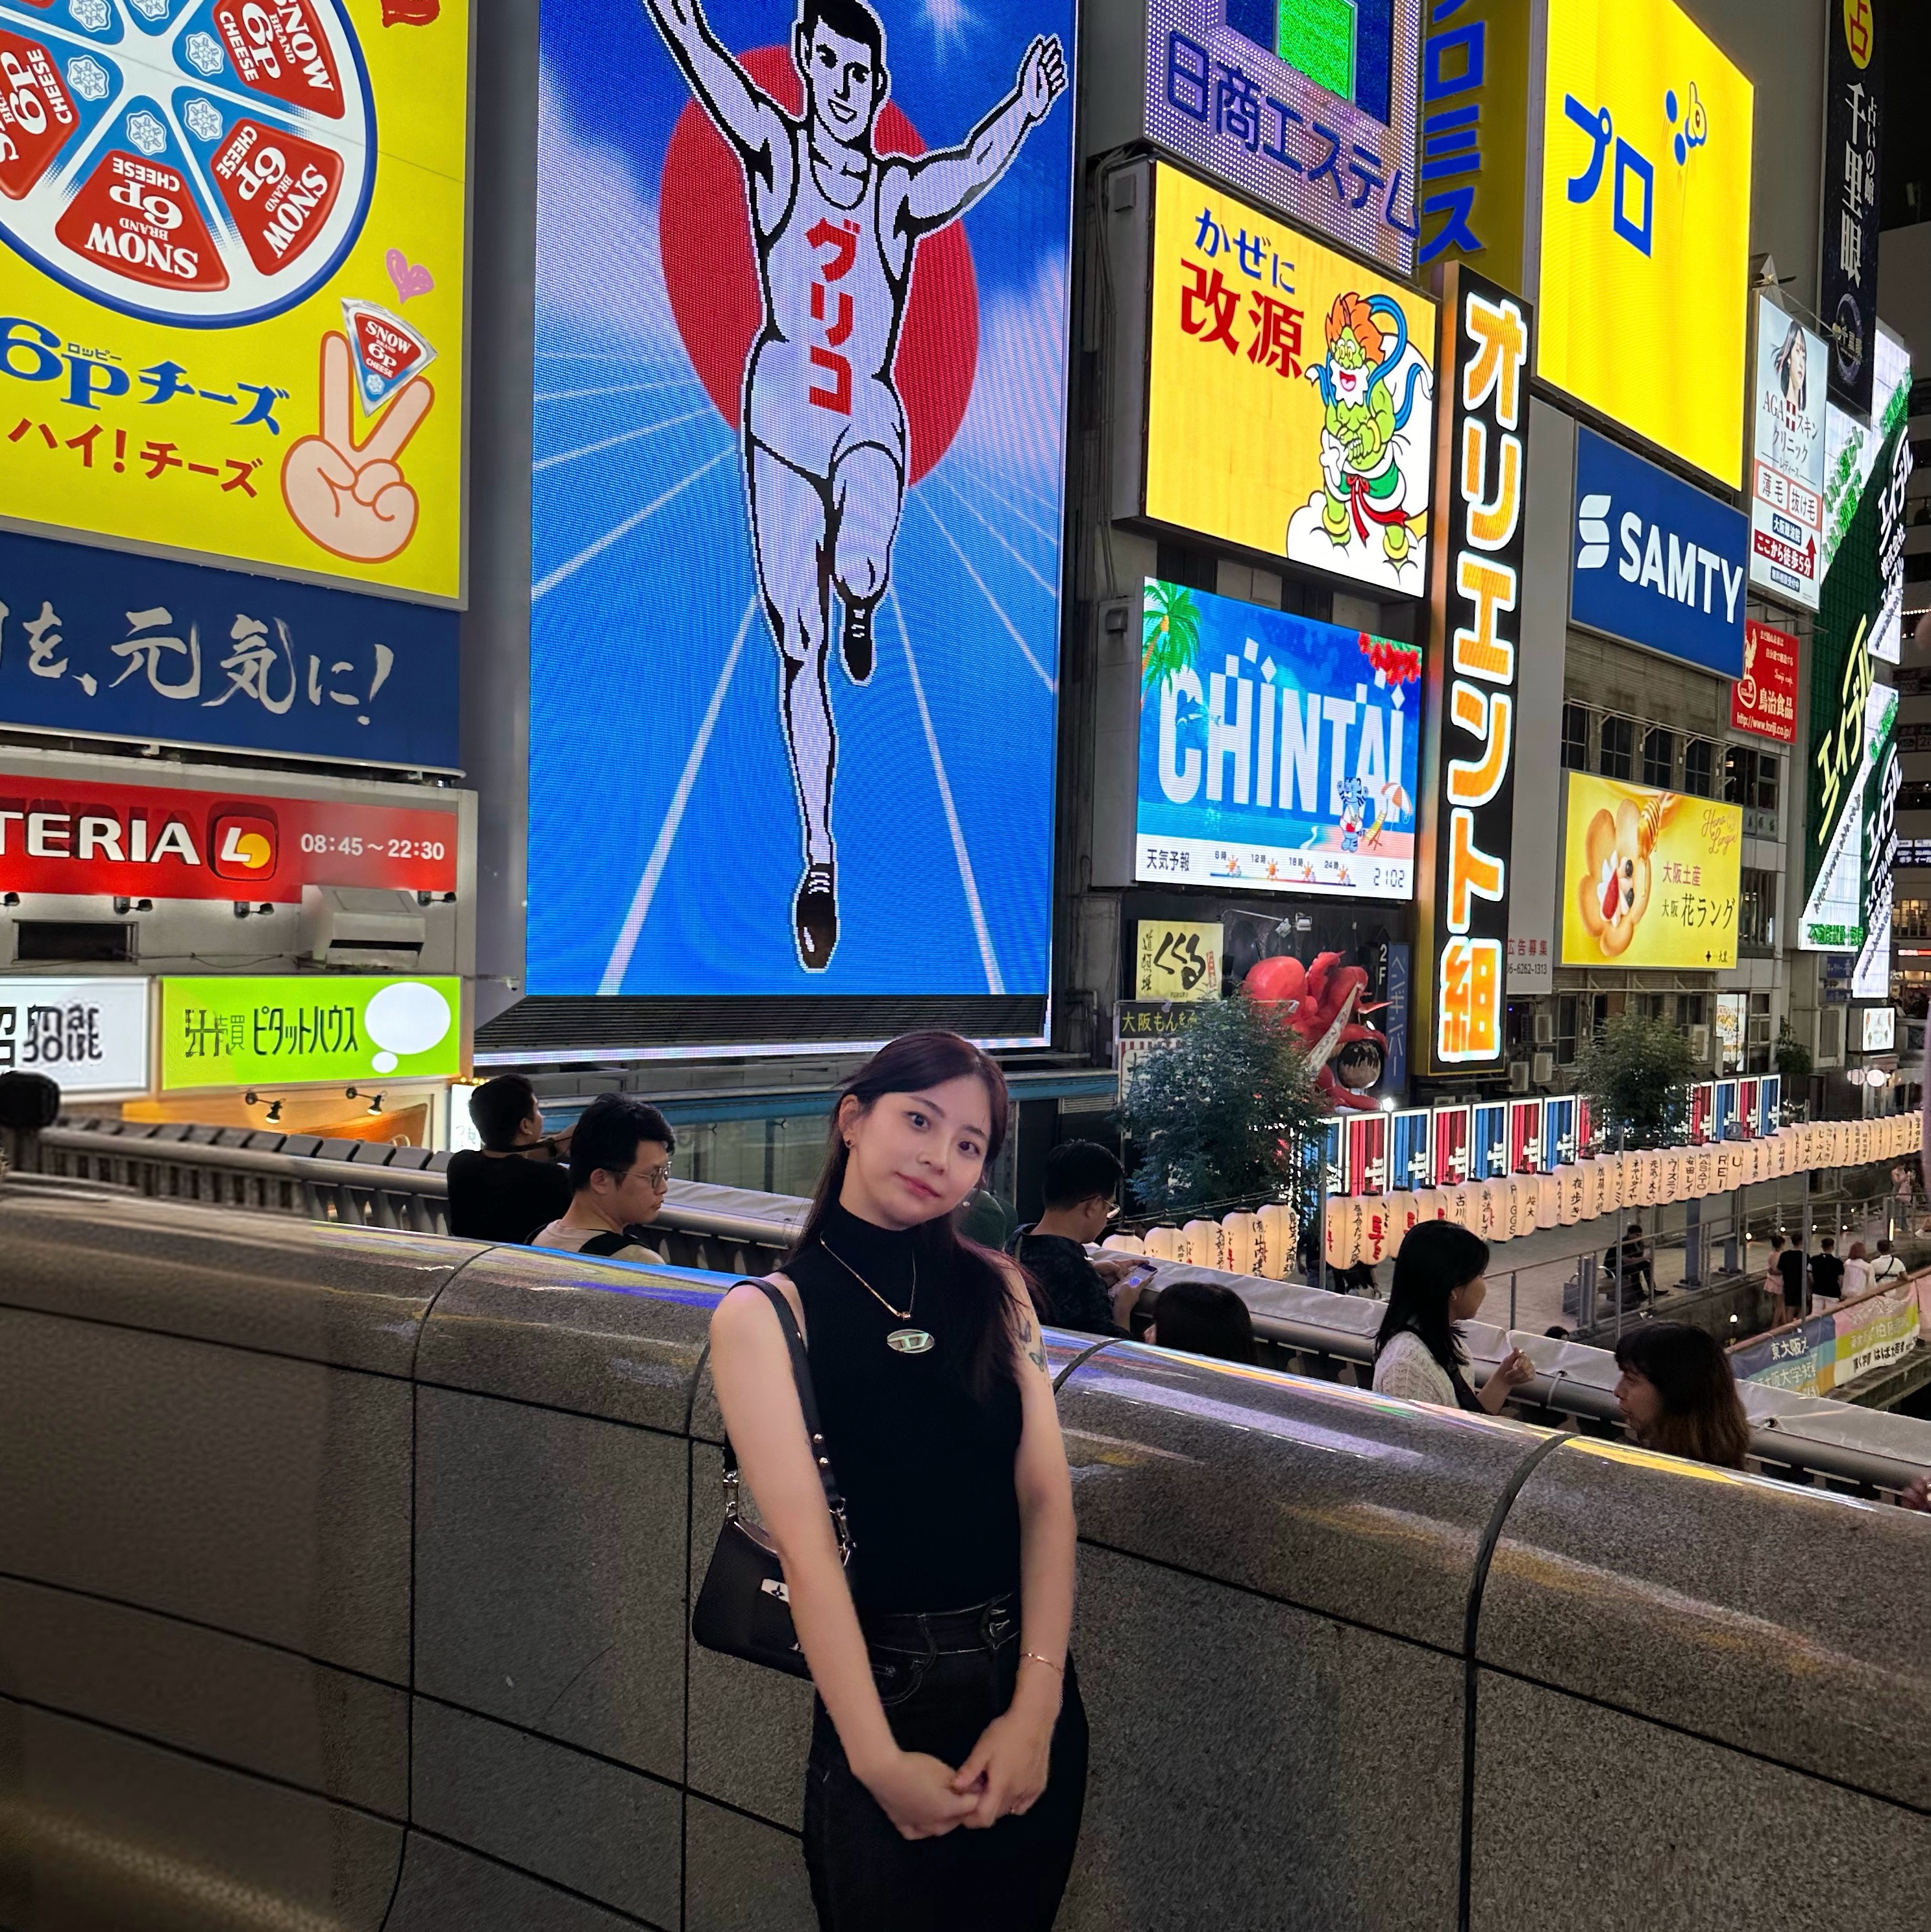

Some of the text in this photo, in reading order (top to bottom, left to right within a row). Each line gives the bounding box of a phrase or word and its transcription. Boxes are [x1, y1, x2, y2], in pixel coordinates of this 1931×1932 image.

[219, 11, 260, 82] CHEESE
[242, 3, 281, 79] 6P
[269, 13, 296, 64] BRAND
[273, 0, 334, 92] NOW
[27, 49, 73, 124] CHEESE
[216, 125, 258, 180] CHEESE
[1420, 0, 1488, 265] ロミス
[112, 156, 180, 192] CHEESE
[238, 147, 286, 201] 6P
[265, 173, 293, 213] BRAND
[1563, 92, 1654, 260] プロ
[1840, 82, 1867, 289] 千里眼
[109, 179, 183, 230] 6P
[119, 217, 169, 242] BRAND
[262, 163, 328, 259] SNOW
[84, 223, 199, 279] SNOW
[1194, 206, 1297, 296] かぜに
[365, 320, 412, 354] SNOW
[805, 217, 861, 416] グリコ
[1179, 257, 1305, 379] 改源
[67, 342, 123, 362] ロッピー
[365, 357, 394, 378] CHEESE
[367, 342, 398, 367] 6P
[1763, 390, 1818, 440] AGA スキン
[1773, 426, 1808, 464] クリニック
[1619, 512, 1743, 624] SAMTY
[1756, 535, 1812, 577] ここから徒歩5分
[0, 601, 395, 726] を、元気に!
[1157, 636, 1406, 823] CHINTAI
[1817, 613, 1875, 846] エイブル
[1147, 848, 1190, 872] 天気予報
[1662, 861, 1701, 887] 大阪土産
[1153, 932, 1206, 990] くくる
[1507, 938, 1547, 956] 広告募集
[254, 1004, 359, 1056] ピタットハウス
[1571, 1178, 1583, 1217] 夜歩き
